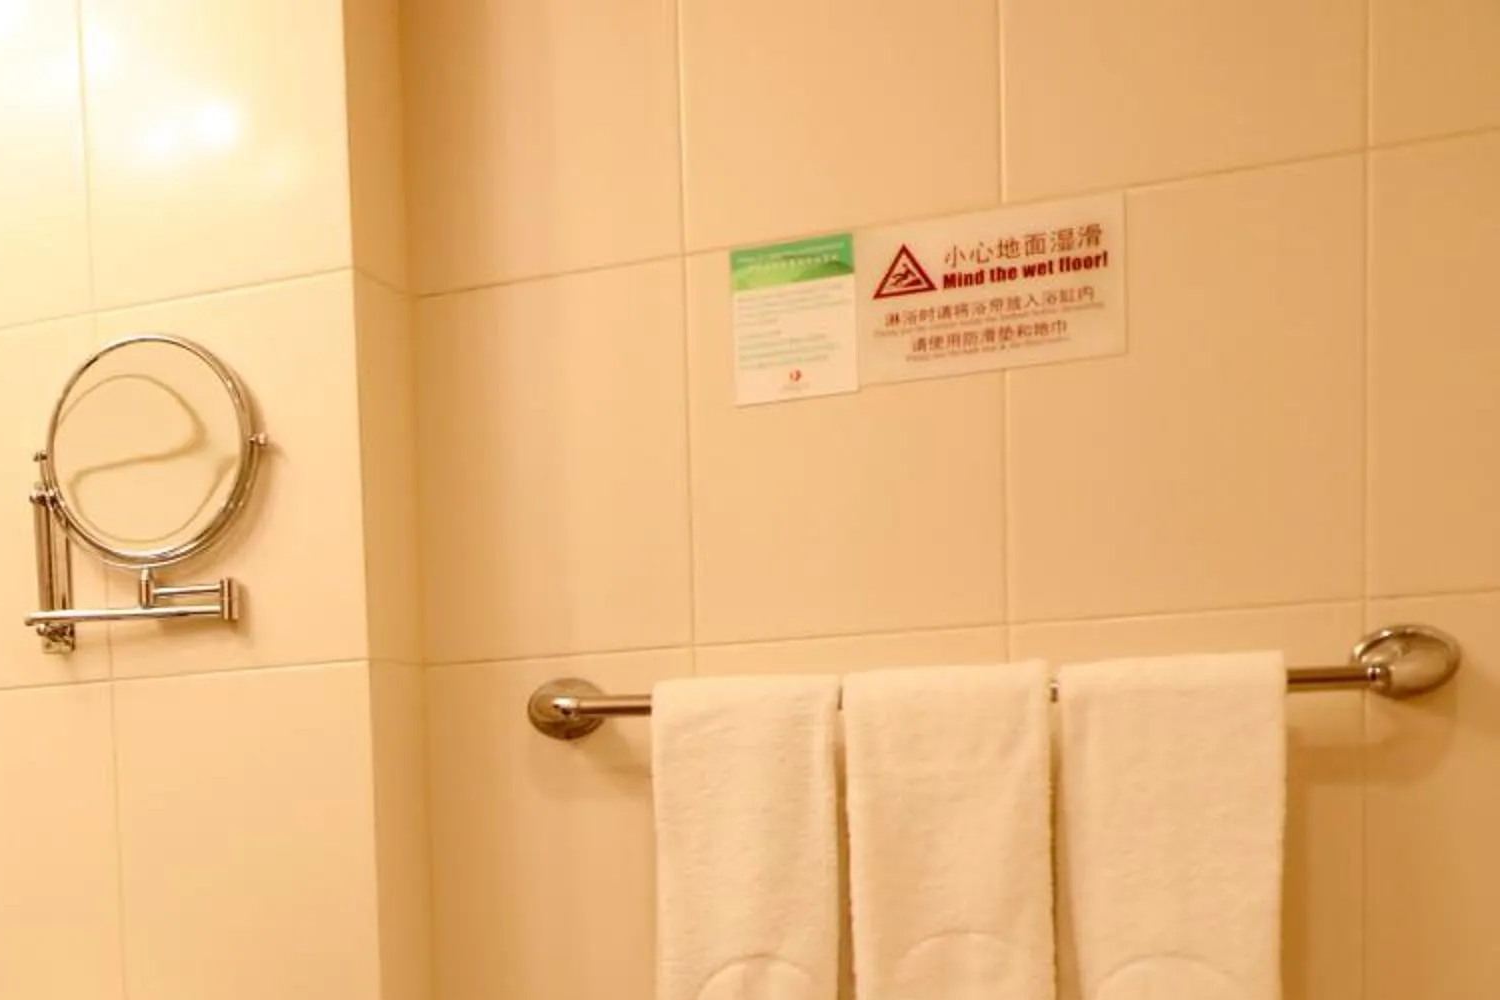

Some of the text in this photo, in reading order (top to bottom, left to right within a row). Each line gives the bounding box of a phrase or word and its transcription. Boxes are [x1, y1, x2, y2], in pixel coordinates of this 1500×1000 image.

[943, 223, 1104, 269] 小心地面湿滑
[942, 250, 1109, 289] Mind the wet floor!
